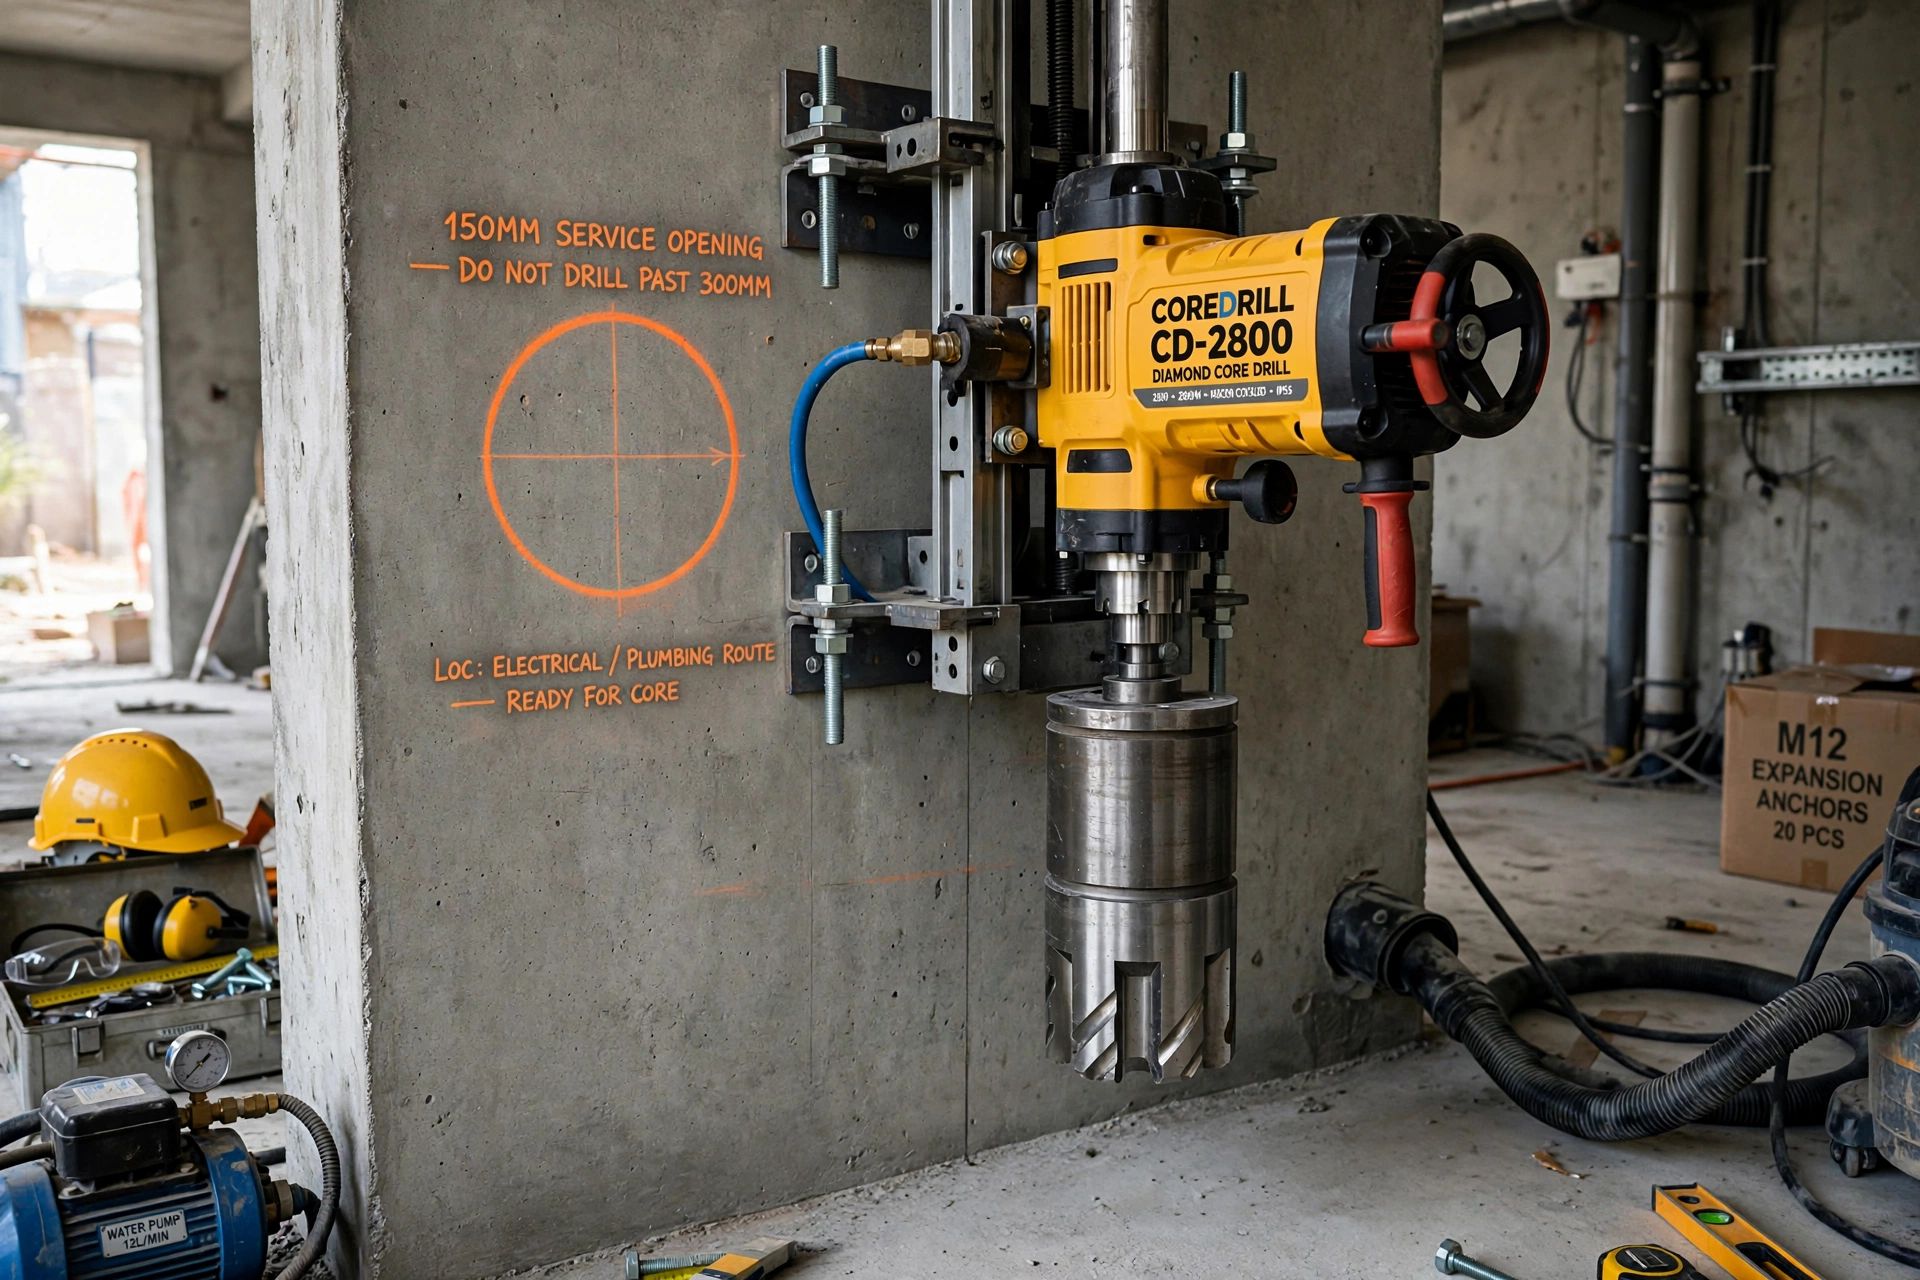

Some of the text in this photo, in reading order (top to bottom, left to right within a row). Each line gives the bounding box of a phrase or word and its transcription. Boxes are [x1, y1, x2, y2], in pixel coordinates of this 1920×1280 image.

[444, 211, 763, 260] 150MM SERVICE OPENING
[459, 256, 771, 298] DO NOT DRILL PAST 300MM
[1151, 285, 1294, 324] COREDRILL
[1151, 318, 1293, 363] CD-2800
[1152, 360, 1290, 383] DIAMOND CORE DRILL
[493, 652, 602, 678] ELECTRICAL
[627, 647, 713, 670] PLUMBING
[723, 642, 776, 664] ROUTE
[507, 681, 680, 713] READY FOR CORE
[1777, 721, 1847, 761] M12
[1752, 758, 1883, 796] EXPANSION
[1756, 789, 1869, 824] ANCHORS
[1773, 820, 1845, 849] 20 PCS
[107, 1214, 180, 1240] WATER PUMP
[124, 1230, 169, 1249] 12L/MIN
